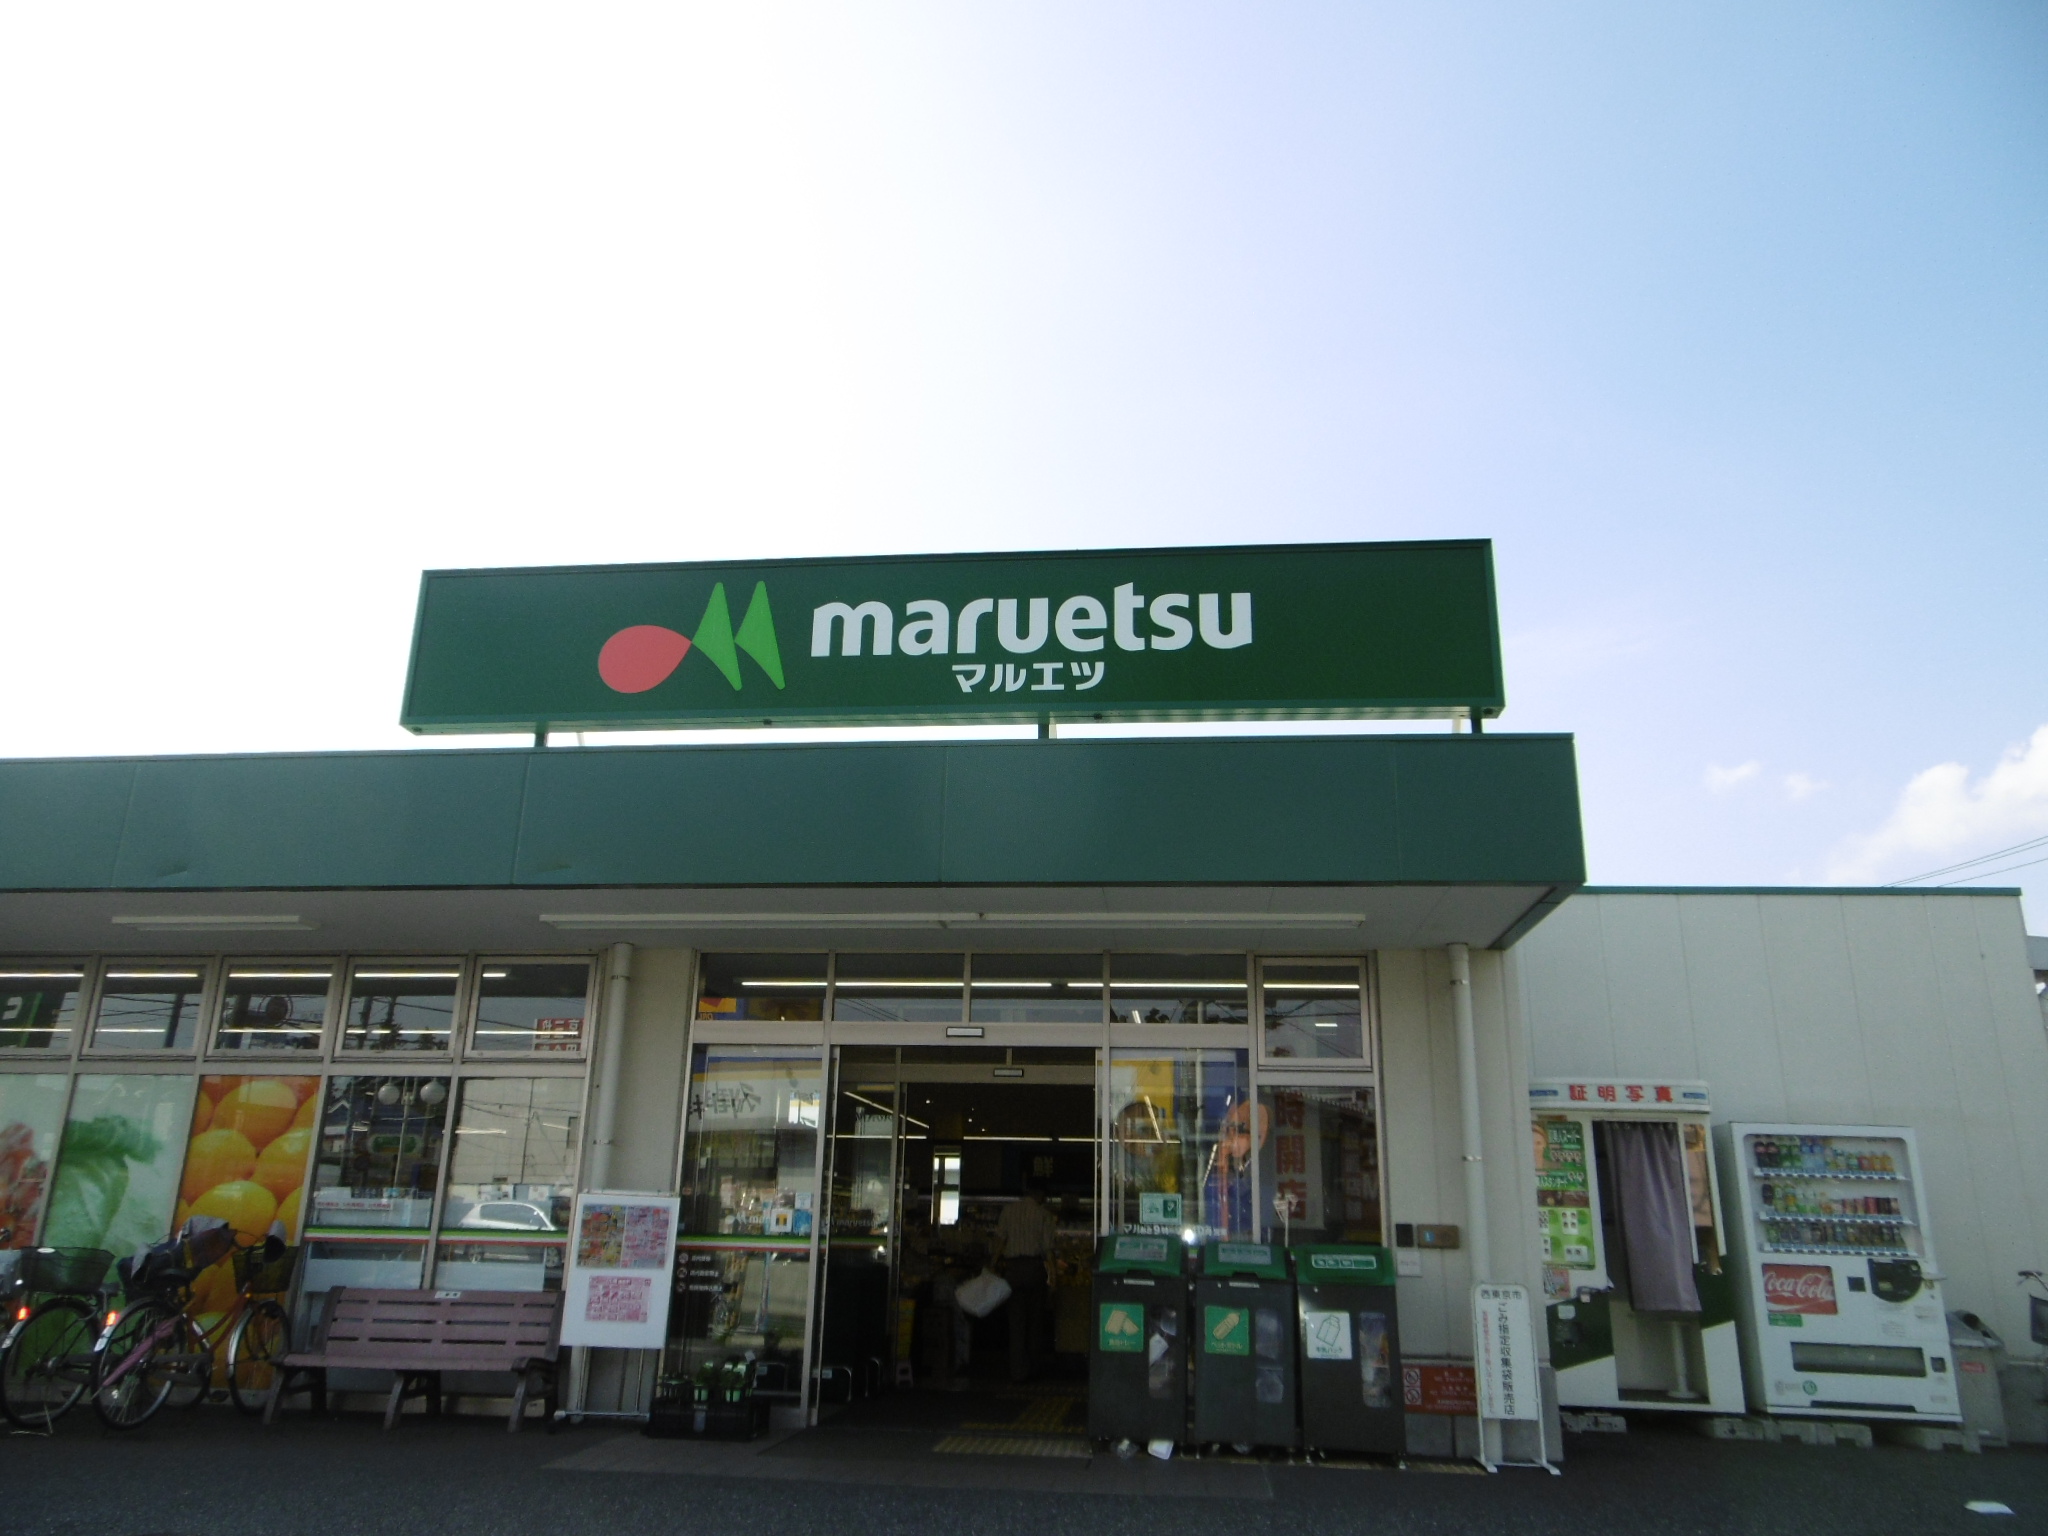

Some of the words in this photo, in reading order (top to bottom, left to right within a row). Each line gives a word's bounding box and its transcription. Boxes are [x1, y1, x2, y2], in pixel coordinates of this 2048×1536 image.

[810, 581, 1252, 657] maruetsu
[951, 661, 1105, 693] マルエツ
[1569, 1084, 1674, 1103] 証明写真
[1481, 1289, 1522, 1300] 西東京市
[1498, 1301, 1515, 1416] ごみ指定収集袋販売店
